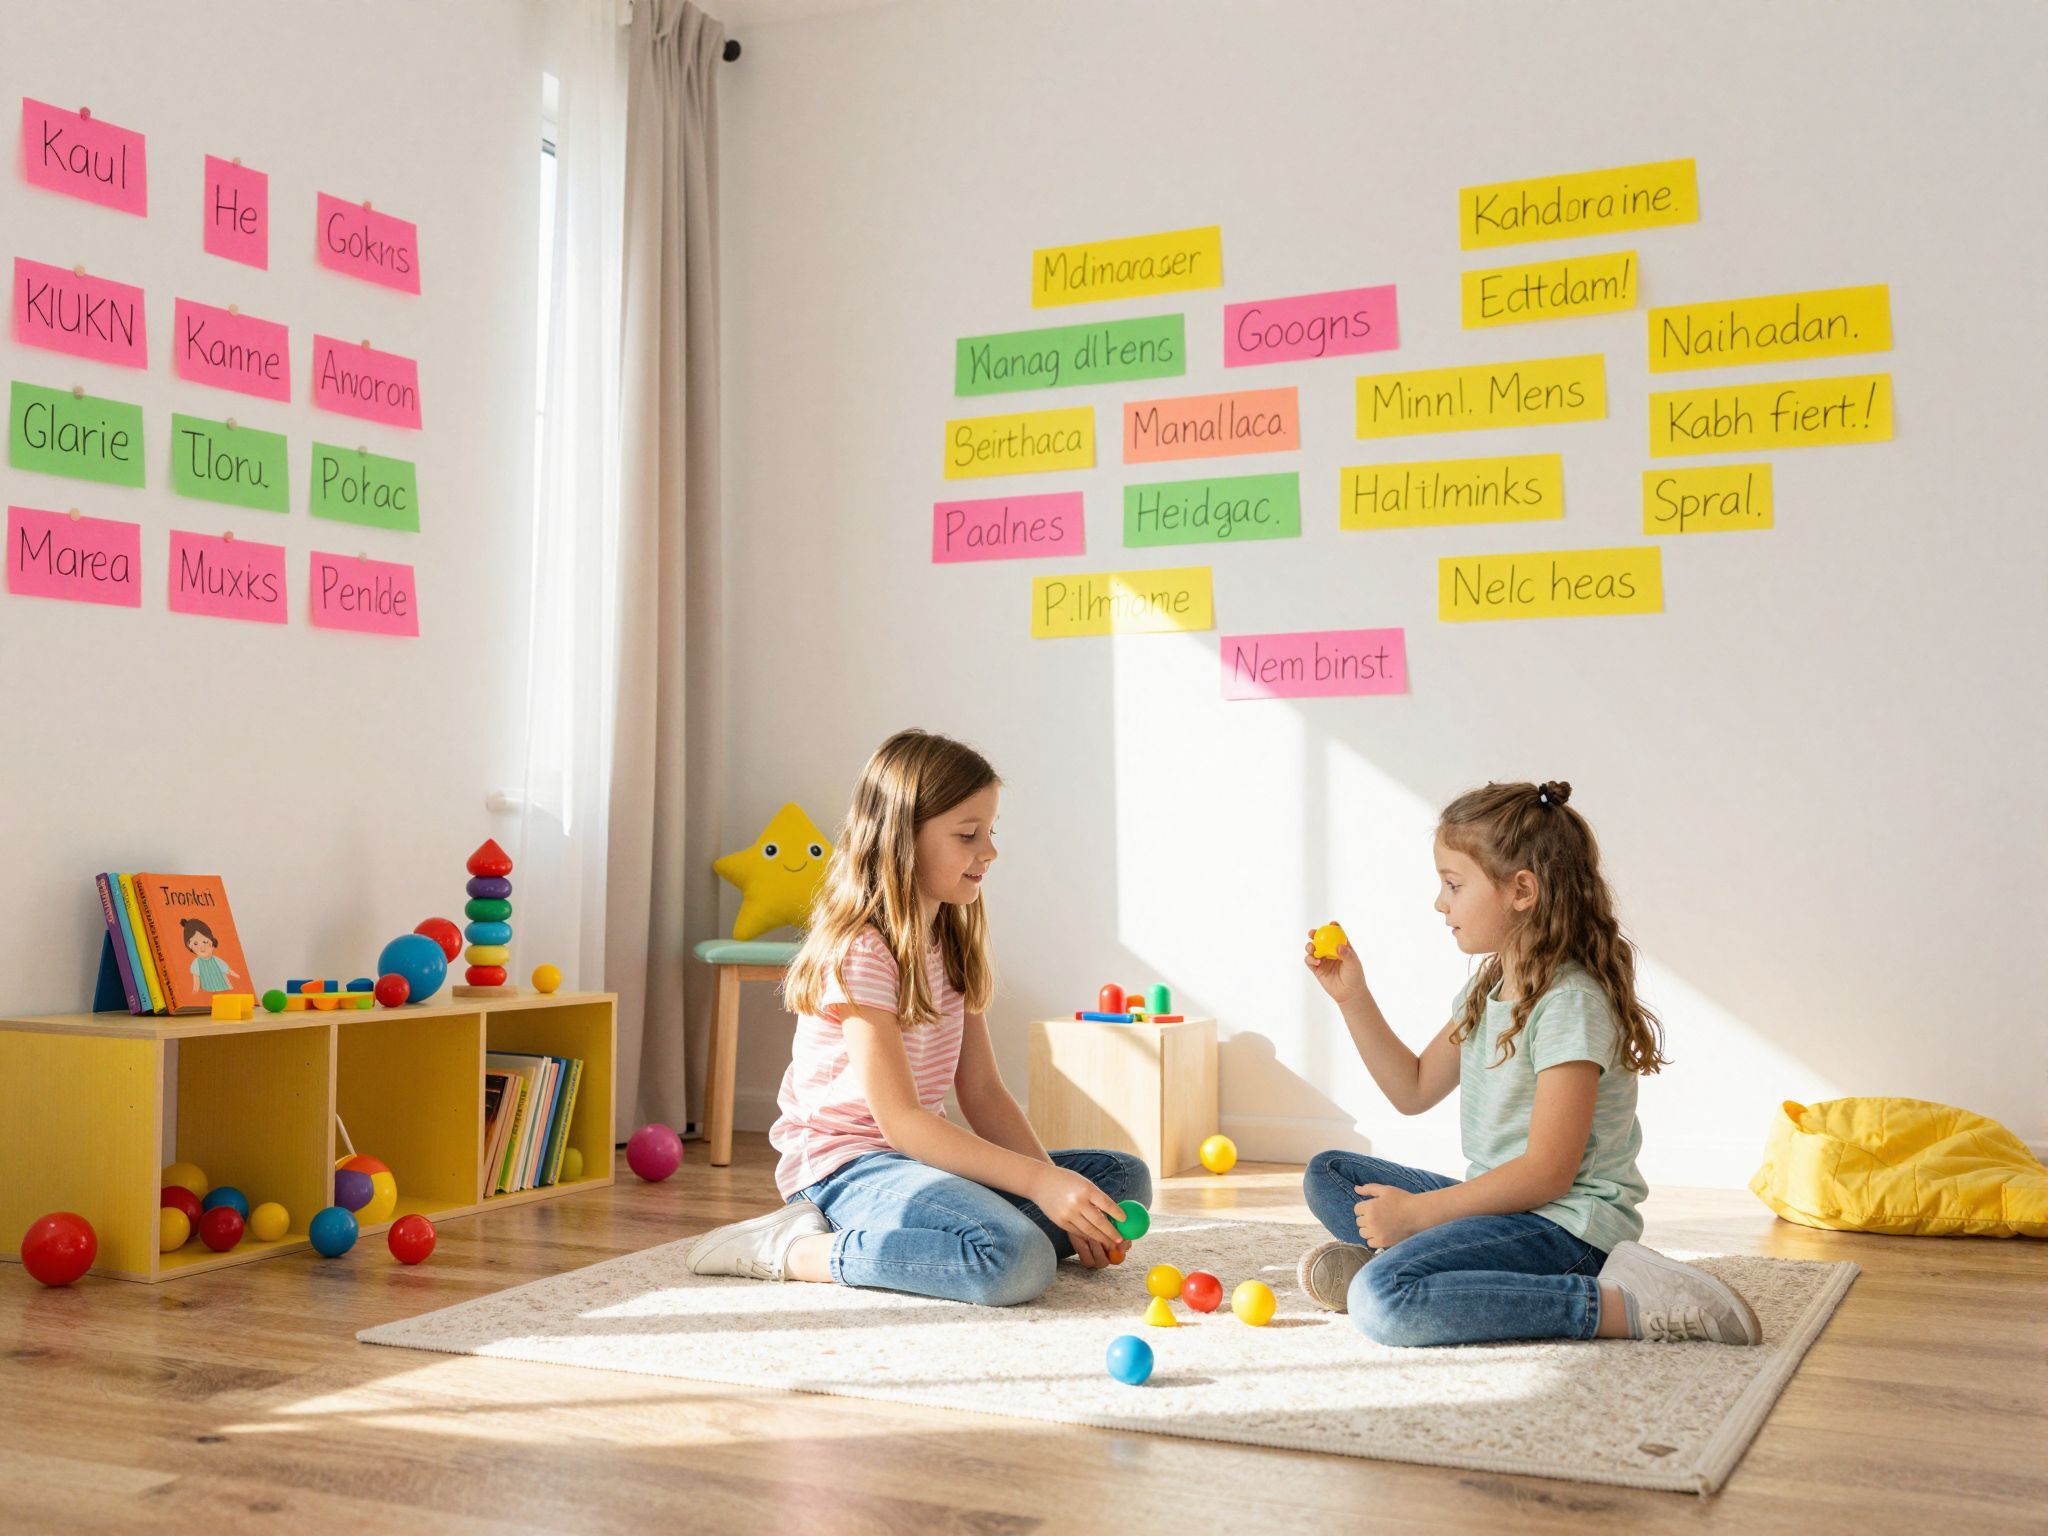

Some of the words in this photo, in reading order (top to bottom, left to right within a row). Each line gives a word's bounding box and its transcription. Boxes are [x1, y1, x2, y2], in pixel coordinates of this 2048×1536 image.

[43, 119, 127, 190] Kaul
[215, 183, 259, 235] He
[186, 315, 281, 381] Kanne
[1237, 308, 1371, 358] Googns
[1662, 302, 1860, 359] Naihadan.
[1489, 371, 1586, 414] Mens
[23, 401, 130, 462] Glarie
[1137, 487, 1281, 539] Heidgac.
[1654, 472, 1763, 534] Spral.
[20, 526, 131, 584] Marea
[1551, 560, 1637, 601] heas
[1234, 642, 1305, 684] Nem
